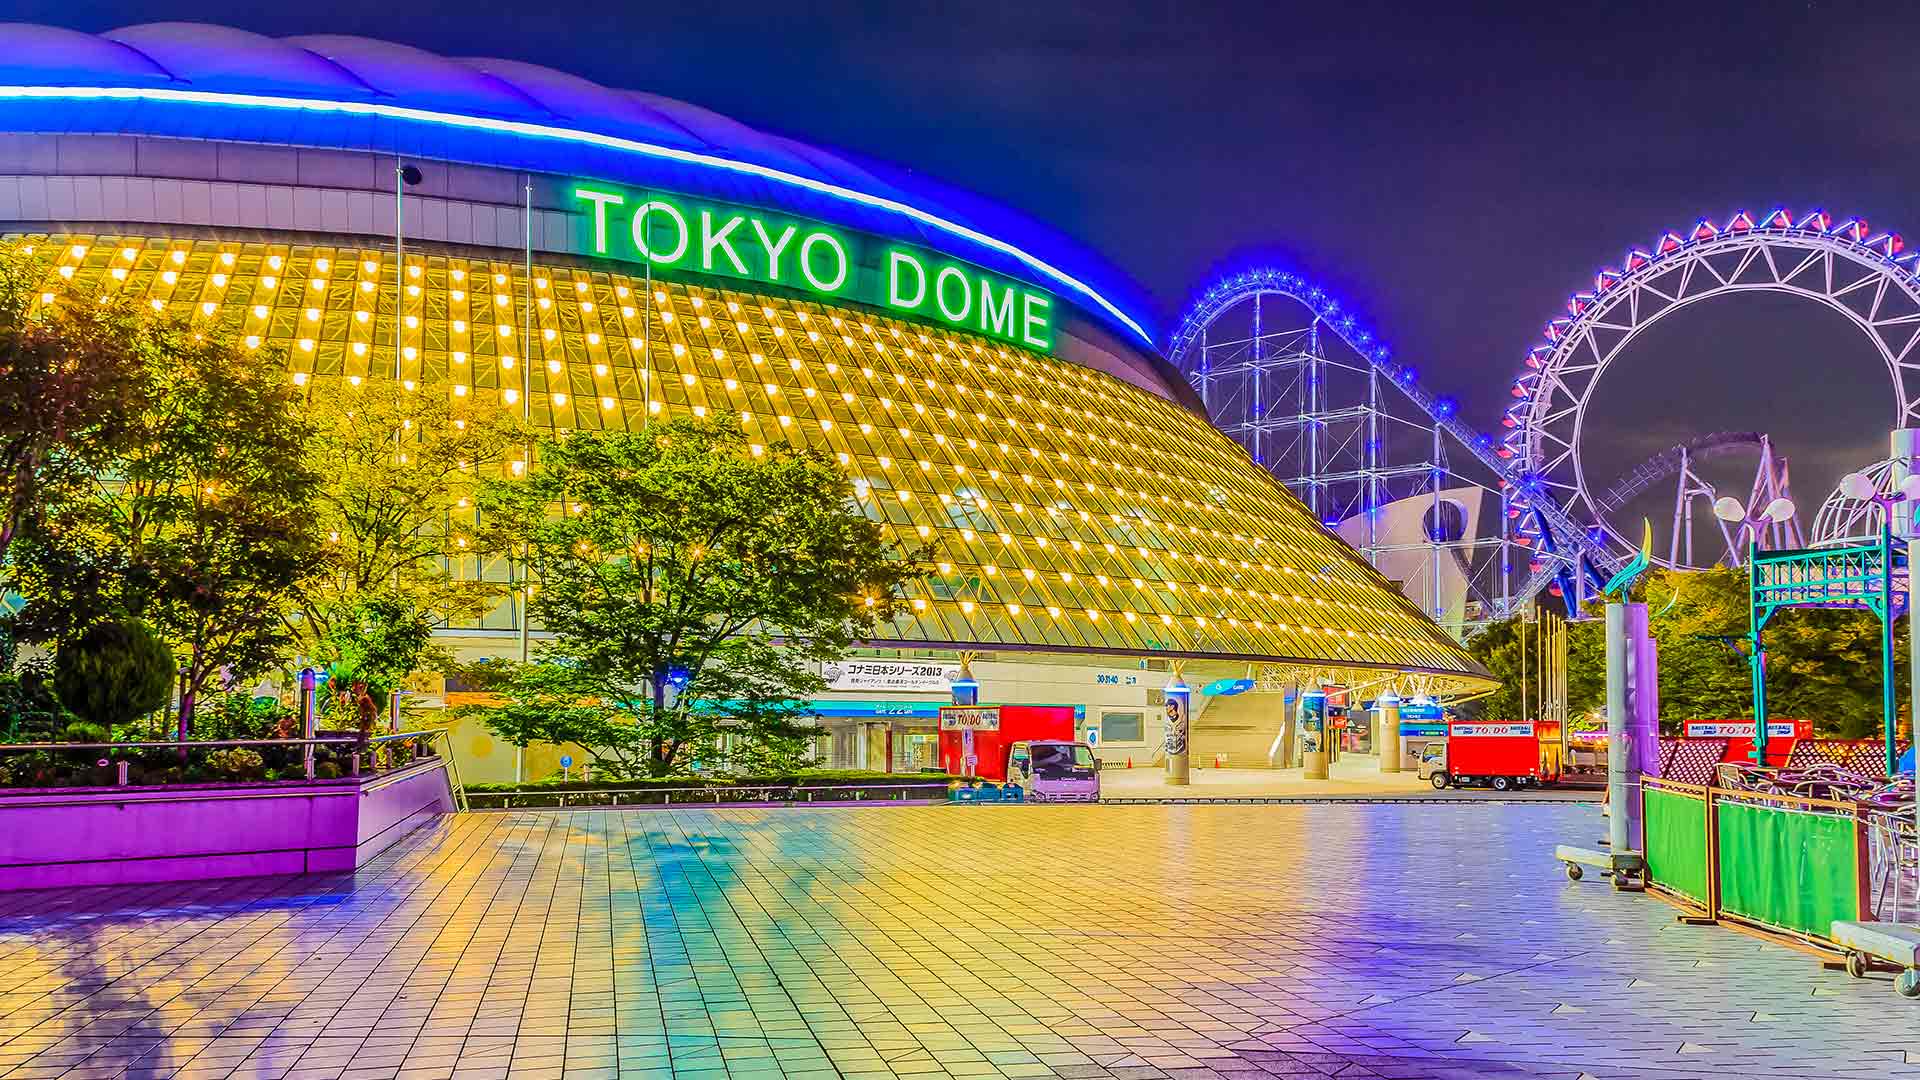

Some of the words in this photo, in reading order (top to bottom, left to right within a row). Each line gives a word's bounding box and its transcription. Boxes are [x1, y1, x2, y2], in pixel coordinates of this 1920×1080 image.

[575, 188, 847, 292] TOKYO
[889, 251, 1050, 349] DOME
[848, 664, 943, 677] コナミ日本シリーズ2013
[888, 704, 904, 715] 22
